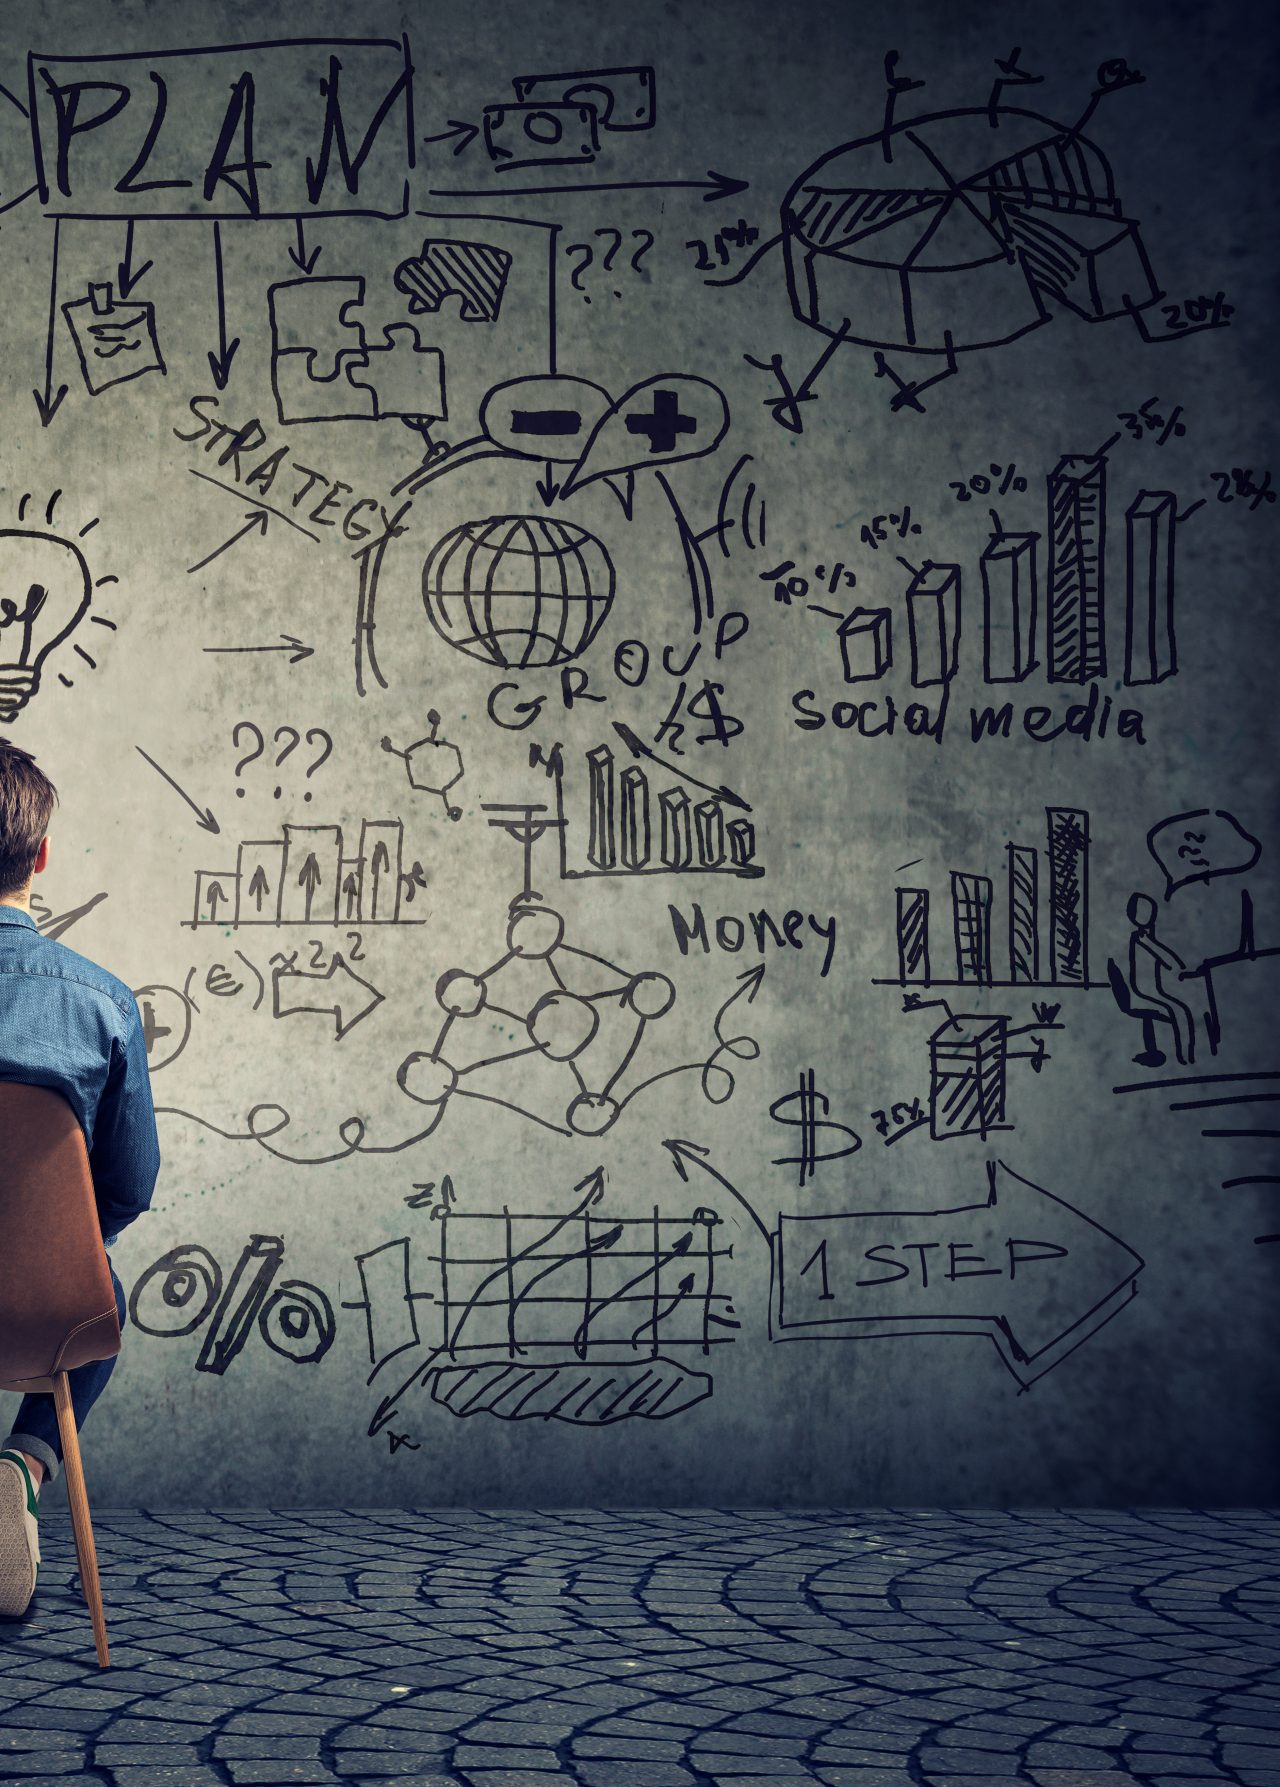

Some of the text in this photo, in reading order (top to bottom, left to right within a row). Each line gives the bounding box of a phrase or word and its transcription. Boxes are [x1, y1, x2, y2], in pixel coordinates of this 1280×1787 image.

[39, 56, 415, 218] PLAN
[173, 396, 413, 559] STRATEGY
[488, 611, 749, 730] GROUP
[970, 683, 1147, 744] media
[232, 721, 333, 802] ???
[668, 903, 835, 977] Money
[770, 1068, 862, 1186] $
[800, 1238, 1068, 1299] 1 STEP
